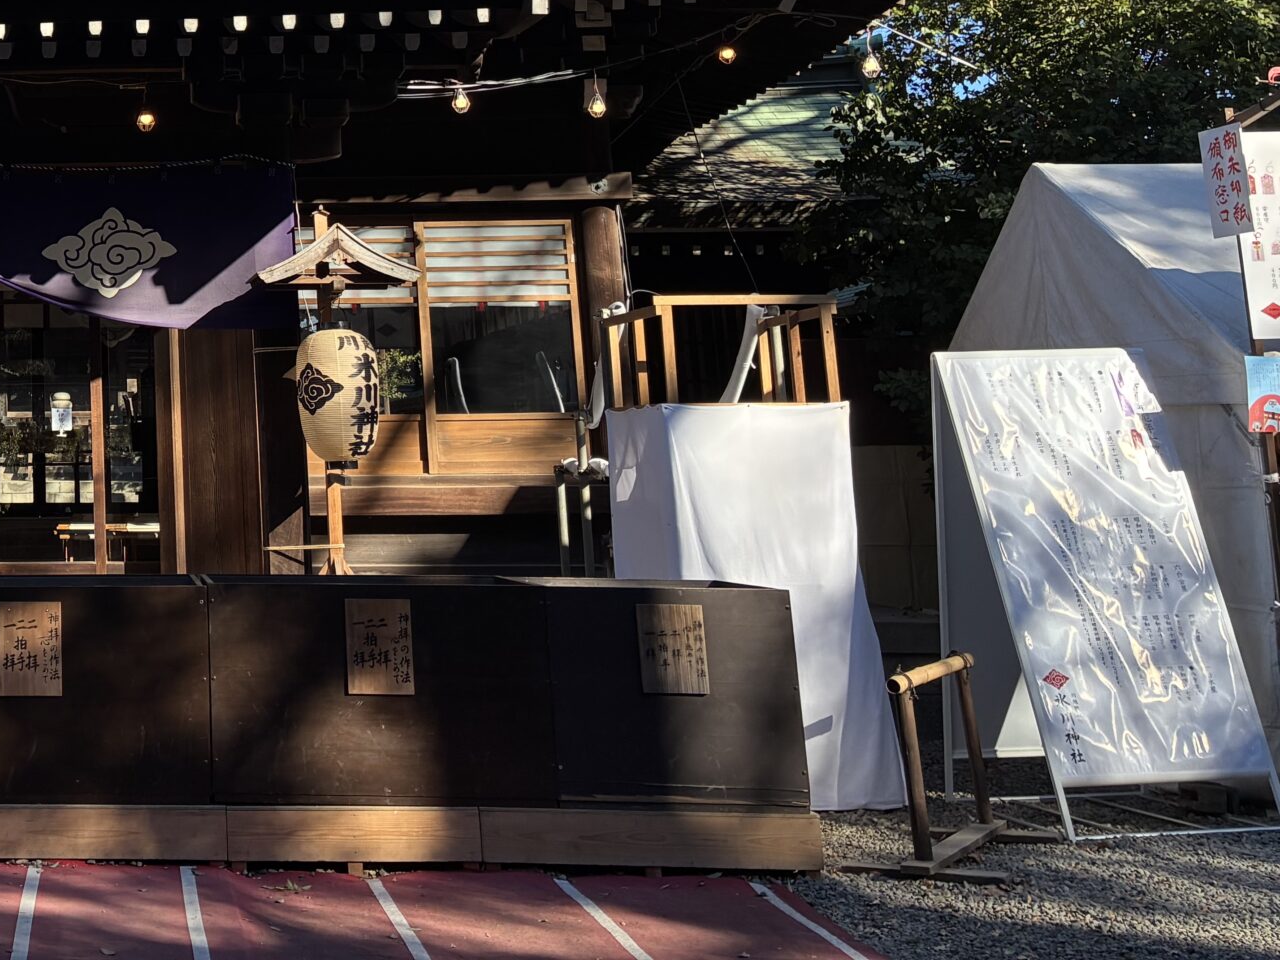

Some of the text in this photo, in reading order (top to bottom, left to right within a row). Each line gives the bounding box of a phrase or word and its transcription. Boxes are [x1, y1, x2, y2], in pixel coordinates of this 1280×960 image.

[1222, 130, 1251, 226] 御朱印紙
[348, 352, 379, 458] 氷川神社
[1054, 693, 1086, 765] 氷川神社
